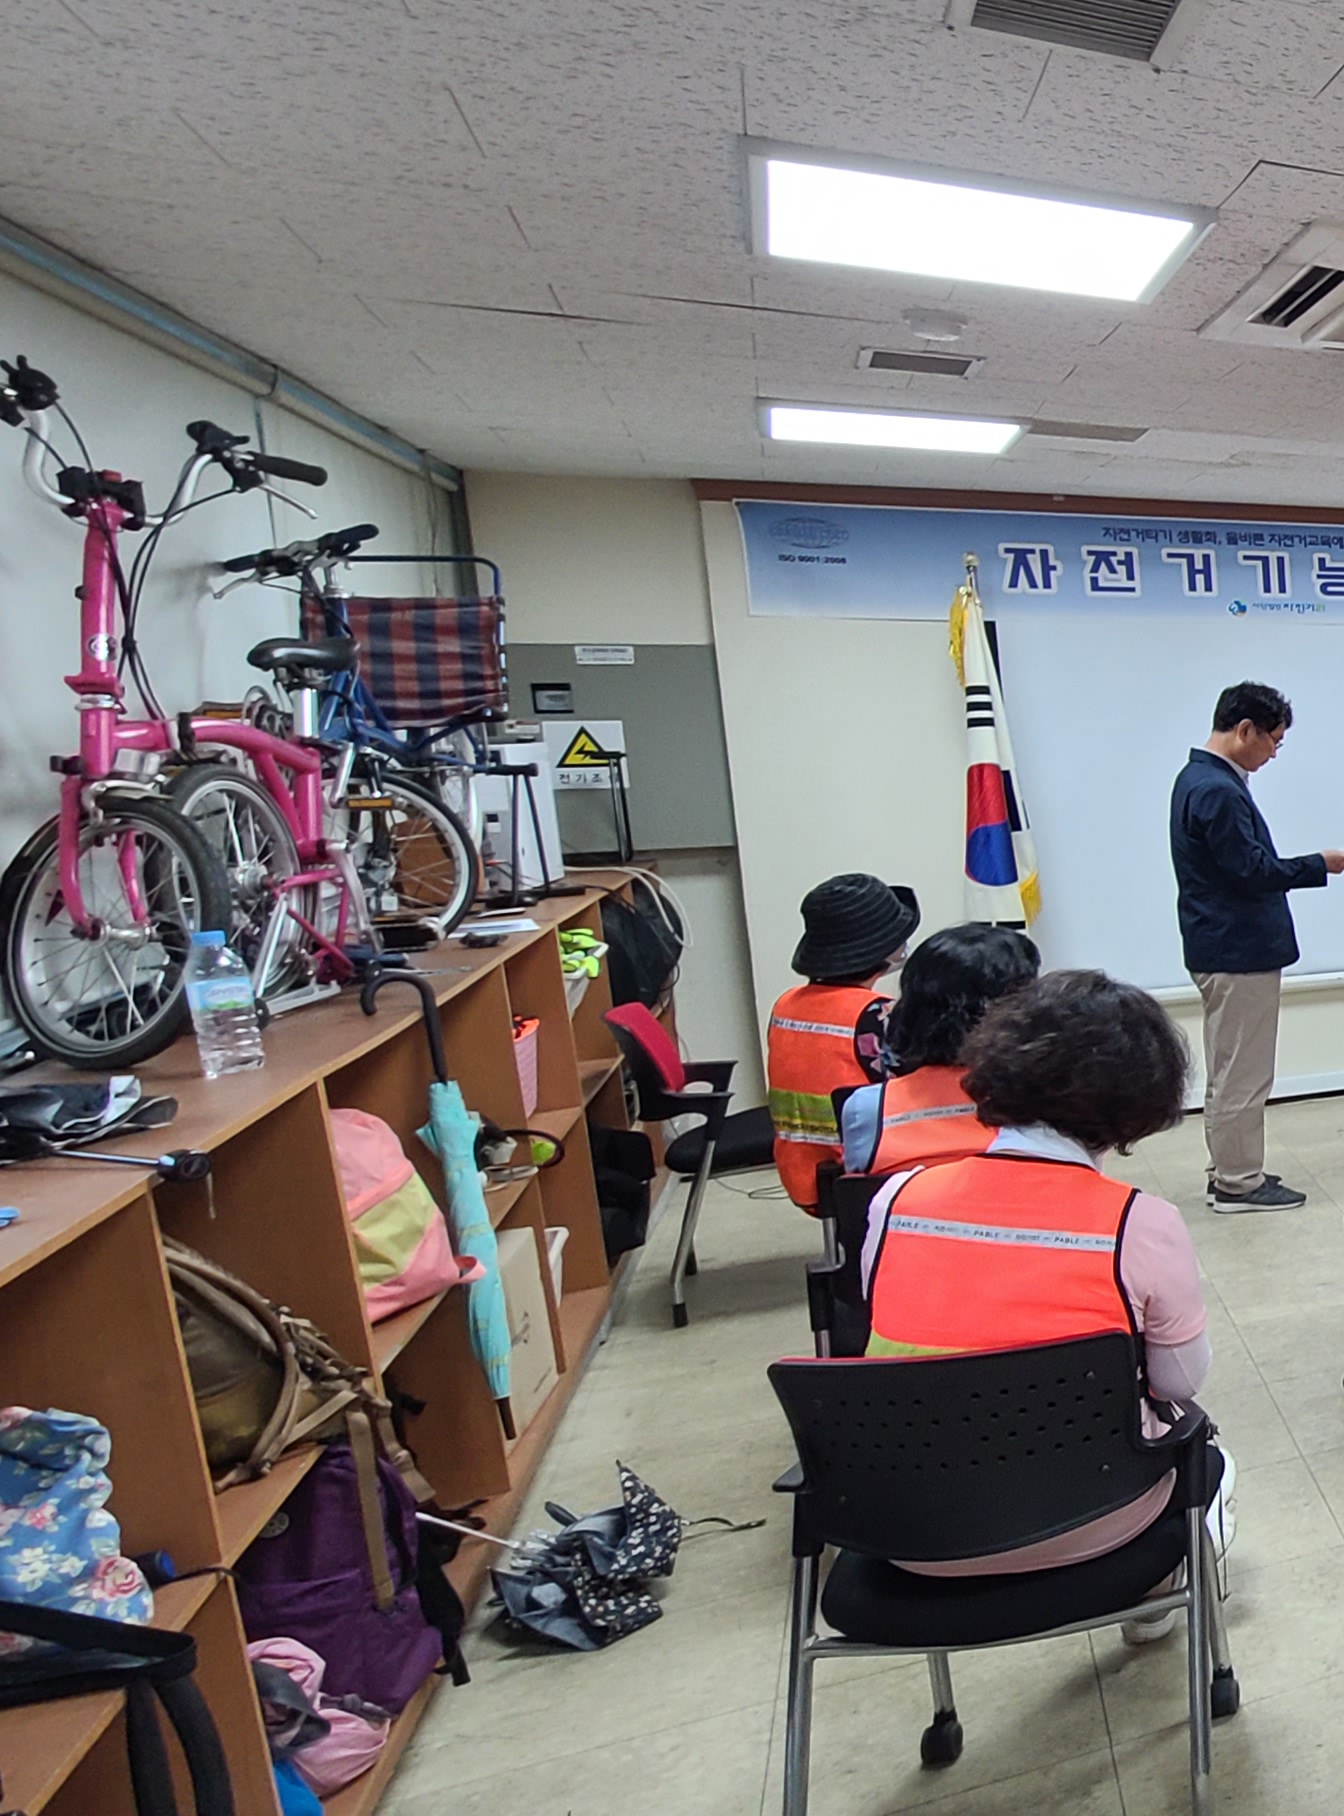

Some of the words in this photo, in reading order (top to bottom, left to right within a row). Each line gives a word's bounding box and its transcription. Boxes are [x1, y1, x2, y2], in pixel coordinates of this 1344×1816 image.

[1102, 527, 1173, 544] 자전거타기
[1176, 529, 1222, 546] 생활화,
[1225, 531, 1266, 546] 올바른
[777, 554, 796, 563] ISO
[558, 773, 611, 784] 전기조
[973, 1229, 1000, 1239] PABLE
[1054, 1236, 1080, 1245] PABLE
